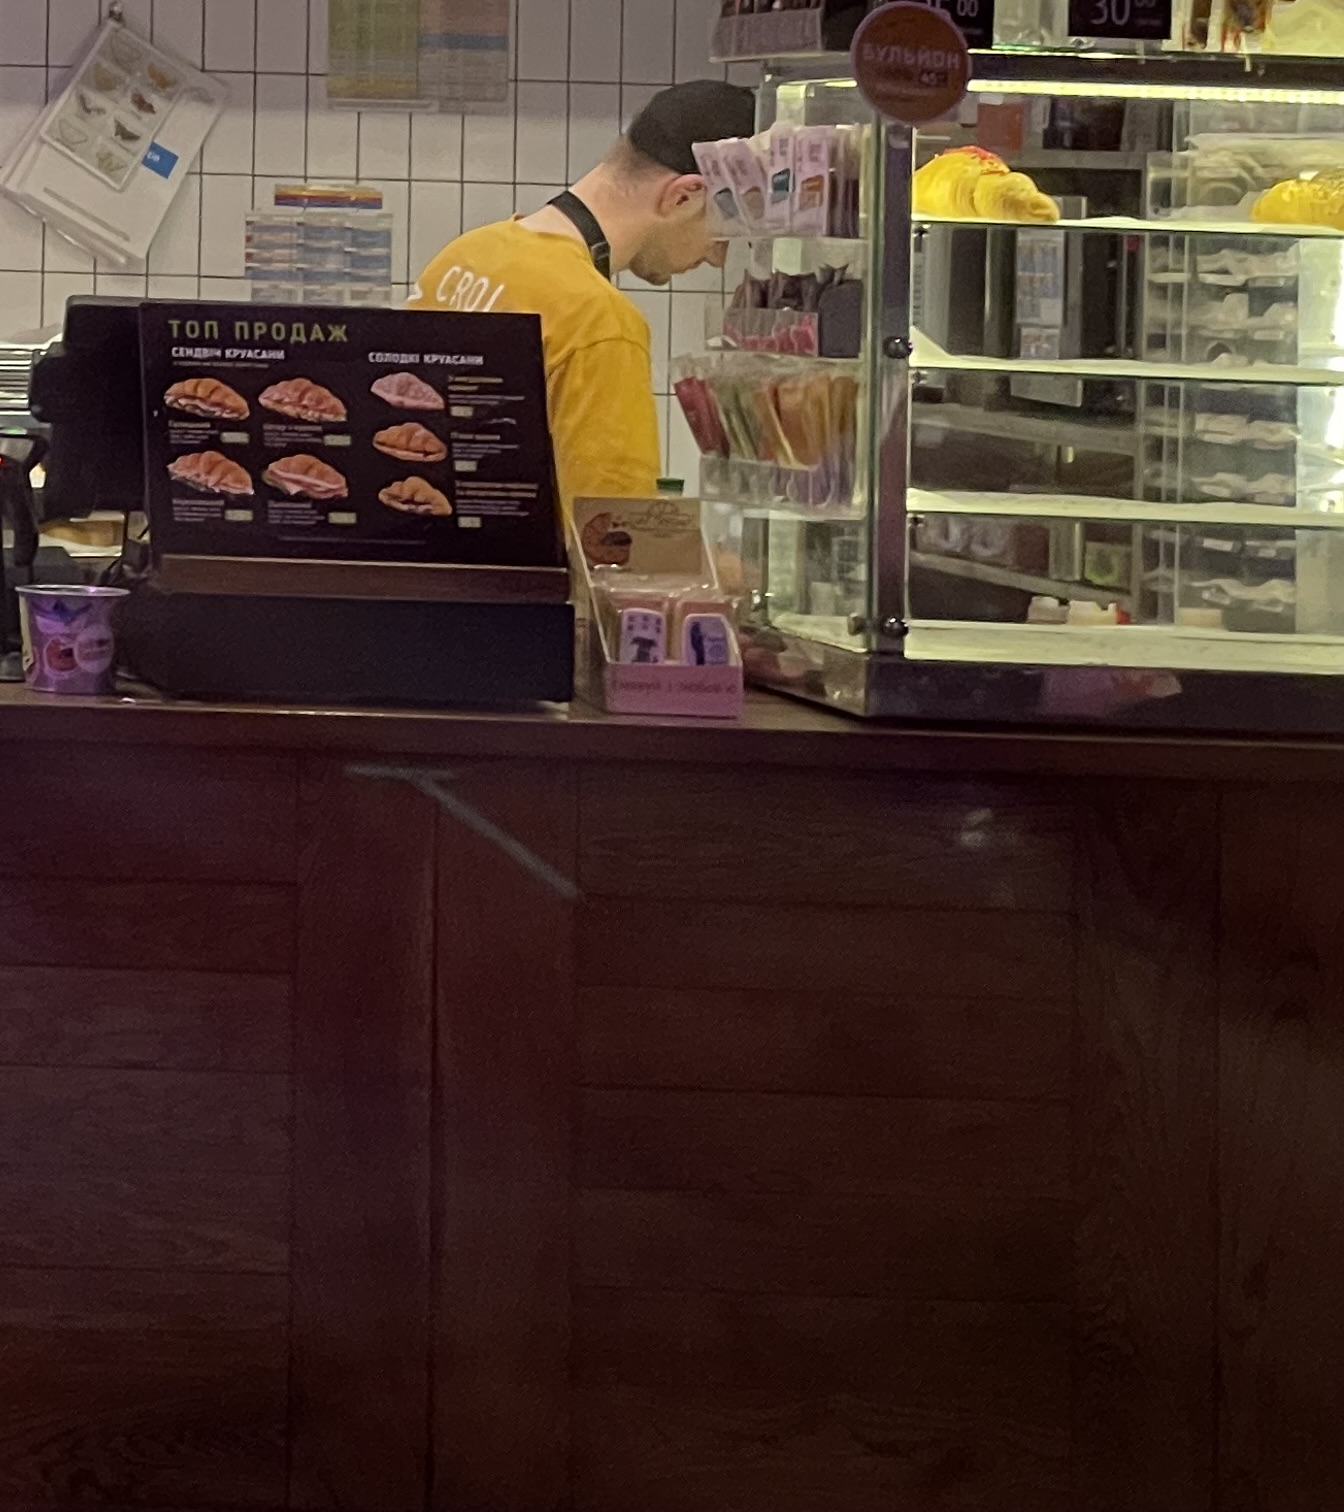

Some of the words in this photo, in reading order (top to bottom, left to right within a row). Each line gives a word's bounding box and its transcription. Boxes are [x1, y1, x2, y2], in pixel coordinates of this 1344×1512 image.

[864, 44, 959, 69] БУЛЬЙОН
[168, 320, 219, 338] ТОП
[235, 322, 348, 343] ПРОДАЖ
[423, 354, 483, 365] КРУАСАНИ
